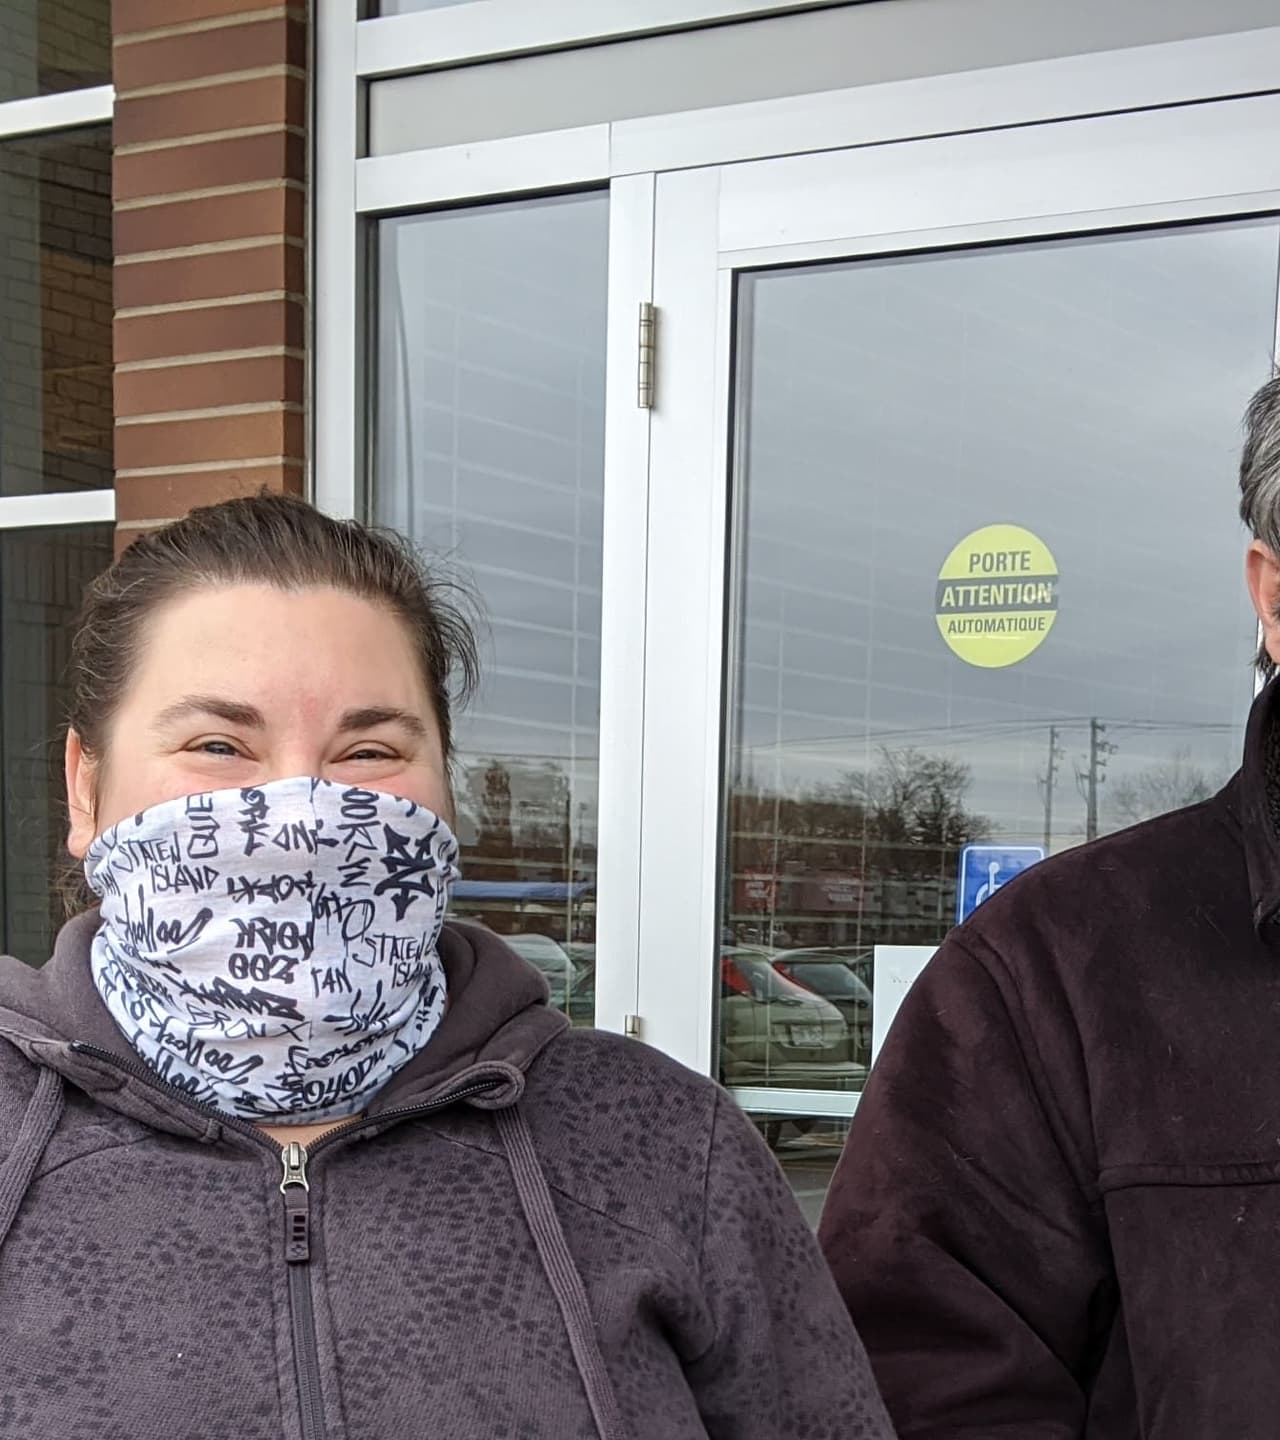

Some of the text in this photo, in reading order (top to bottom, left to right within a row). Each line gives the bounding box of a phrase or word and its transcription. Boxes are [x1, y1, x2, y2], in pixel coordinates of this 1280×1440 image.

[968, 551, 1031, 572] PORTE
[941, 582, 1052, 607] ATTENTION
[947, 617, 1046, 633] AUTOMATIQUE
